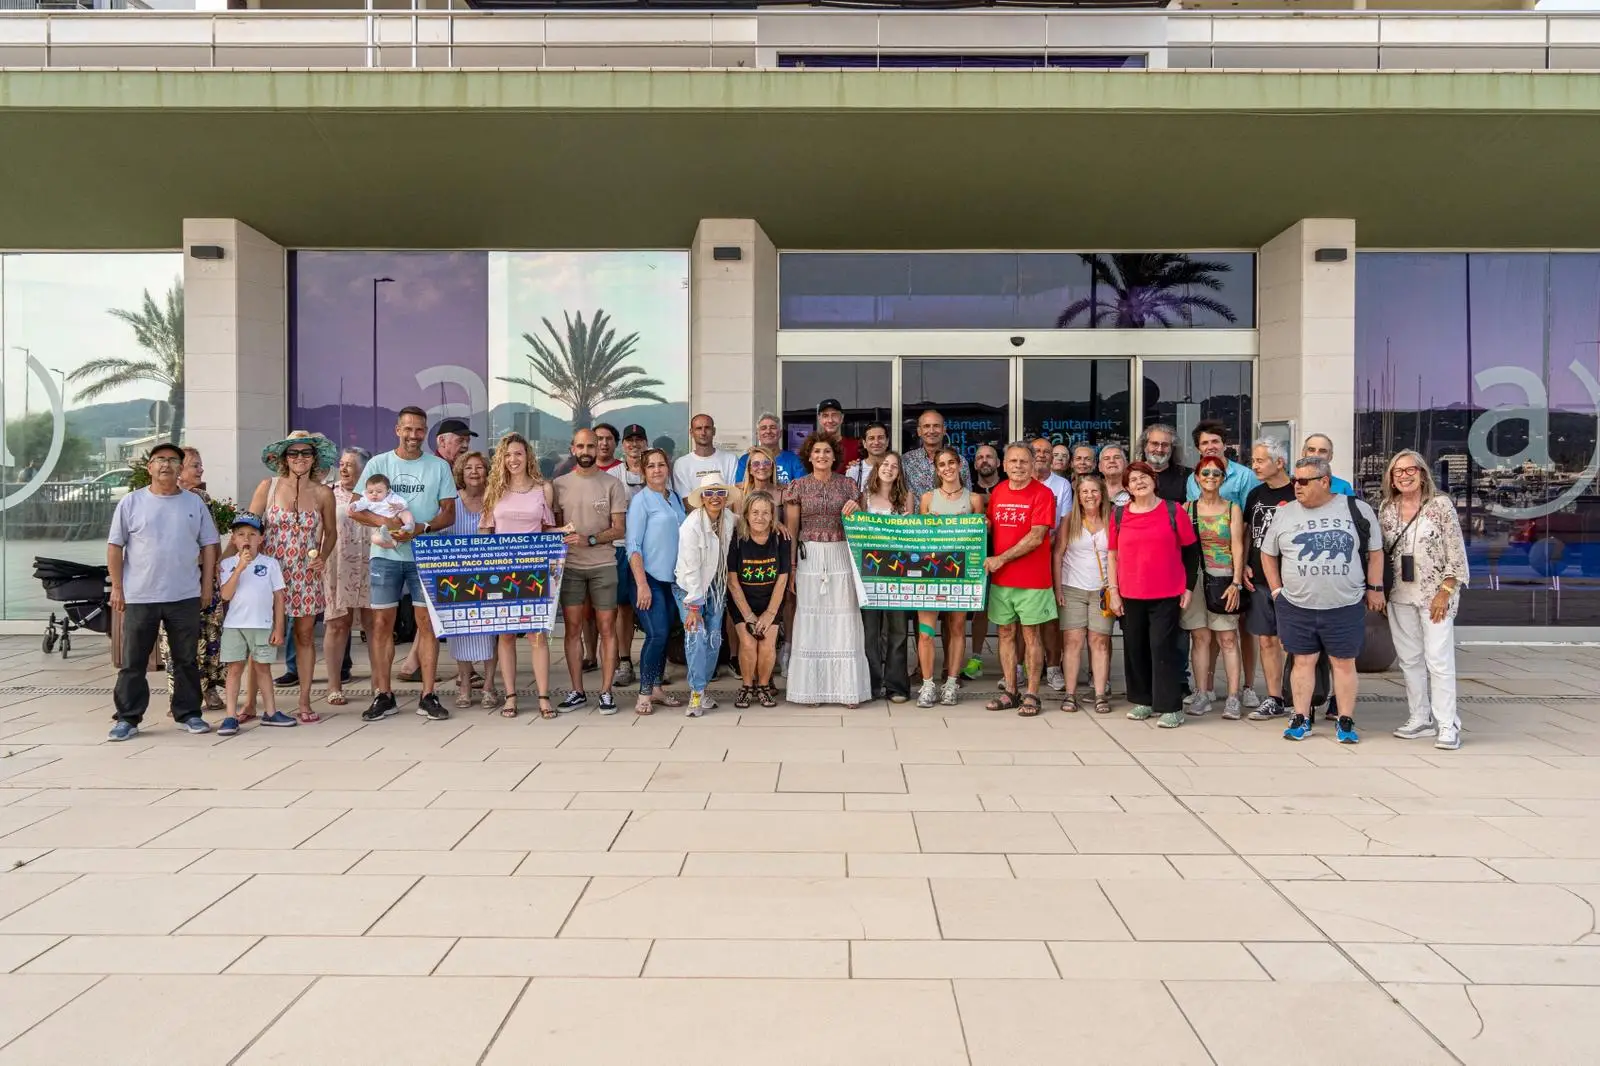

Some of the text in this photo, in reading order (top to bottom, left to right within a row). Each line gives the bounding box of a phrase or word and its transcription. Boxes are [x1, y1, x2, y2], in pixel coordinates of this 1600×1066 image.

[1042, 418, 1113, 432] ajuntament
[390, 484, 425, 494] UIKSILVER
[858, 516, 883, 524] MILLA
[1307, 518, 1353, 530] BEST
[499, 535, 530, 544] (MASC
[540, 534, 564, 543] FEM)
[1314, 532, 1348, 542] PAPA
[1316, 541, 1348, 552] BEAR
[1298, 564, 1350, 576] WORLD
